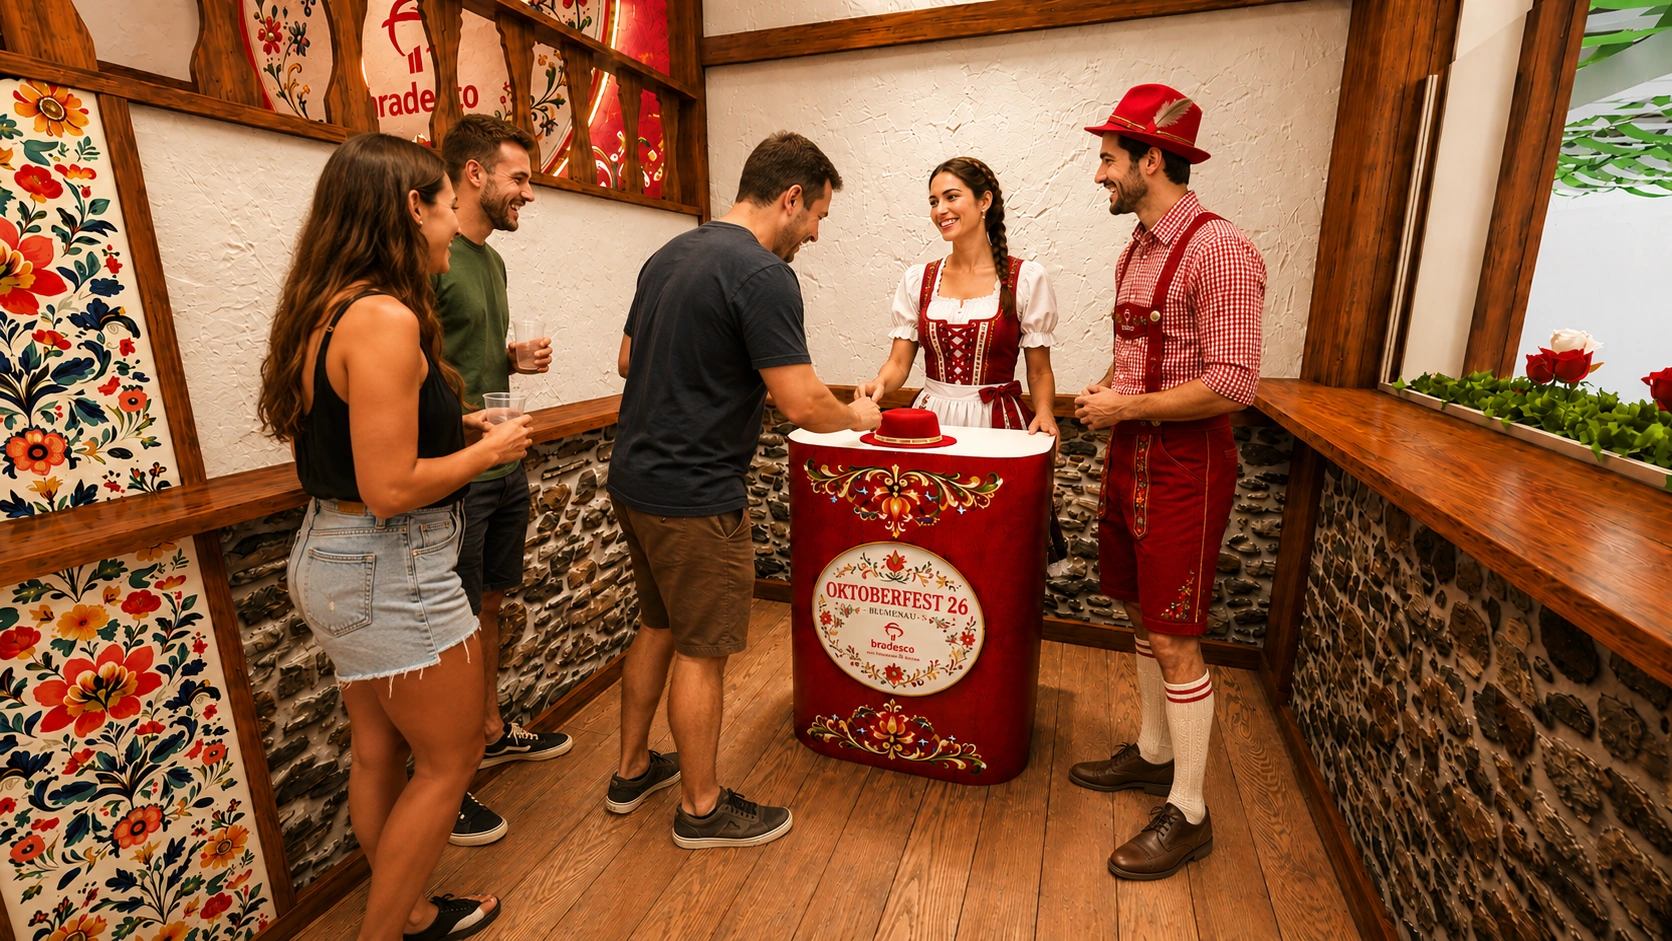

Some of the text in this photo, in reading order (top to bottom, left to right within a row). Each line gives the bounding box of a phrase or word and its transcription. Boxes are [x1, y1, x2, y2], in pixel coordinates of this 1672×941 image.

[371, 82, 478, 118] radeo
[826, 581, 968, 615] OKTOBERFEST 26
[871, 639, 915, 654] bradesco
